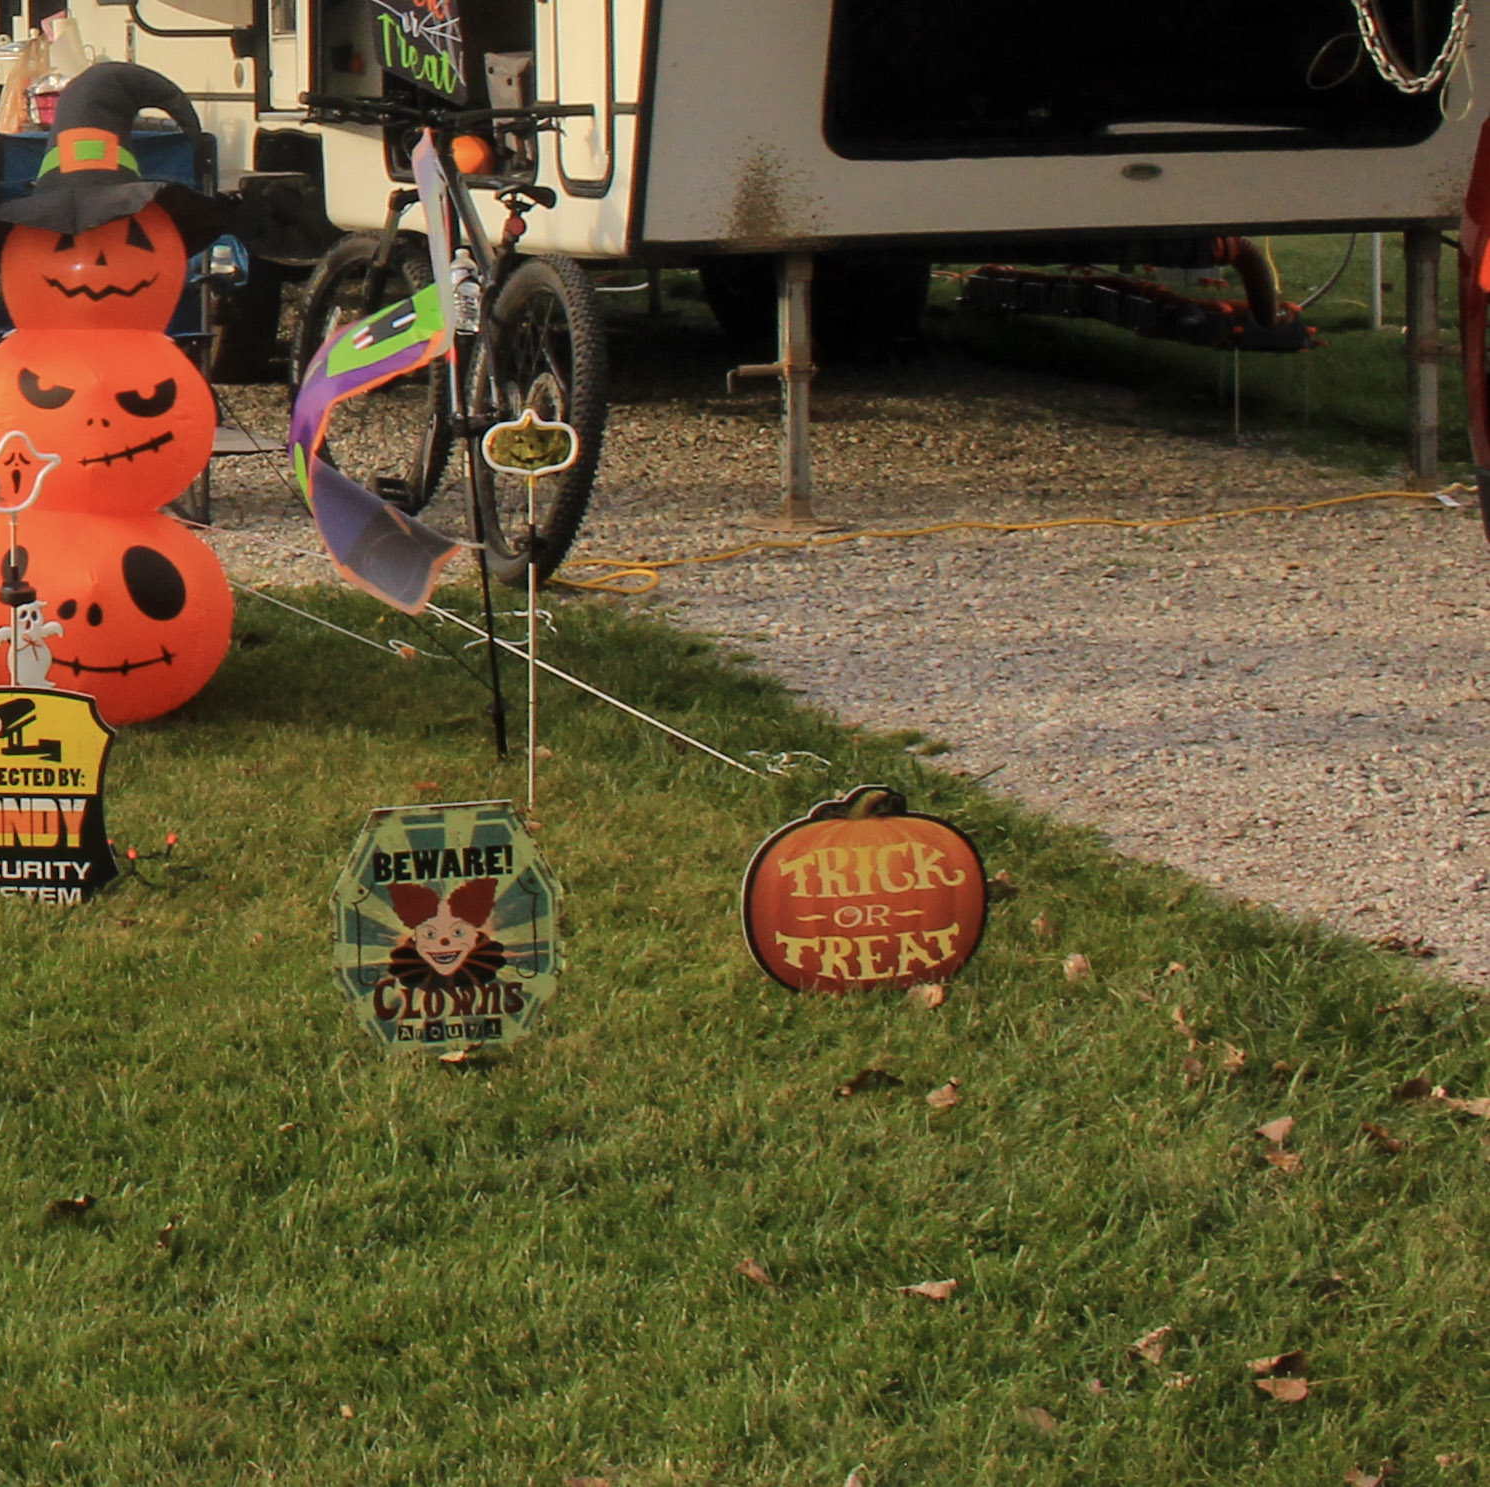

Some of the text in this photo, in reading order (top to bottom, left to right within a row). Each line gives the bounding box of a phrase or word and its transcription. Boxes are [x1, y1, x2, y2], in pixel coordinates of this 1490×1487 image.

[376, 12, 457, 94] Treat
[58, 767, 86, 788] BY:
[373, 844, 514, 883] BEWARE!
[778, 841, 966, 898] TRICK
[833, 904, 891, 929] OR
[775, 922, 961, 981] TREAT
